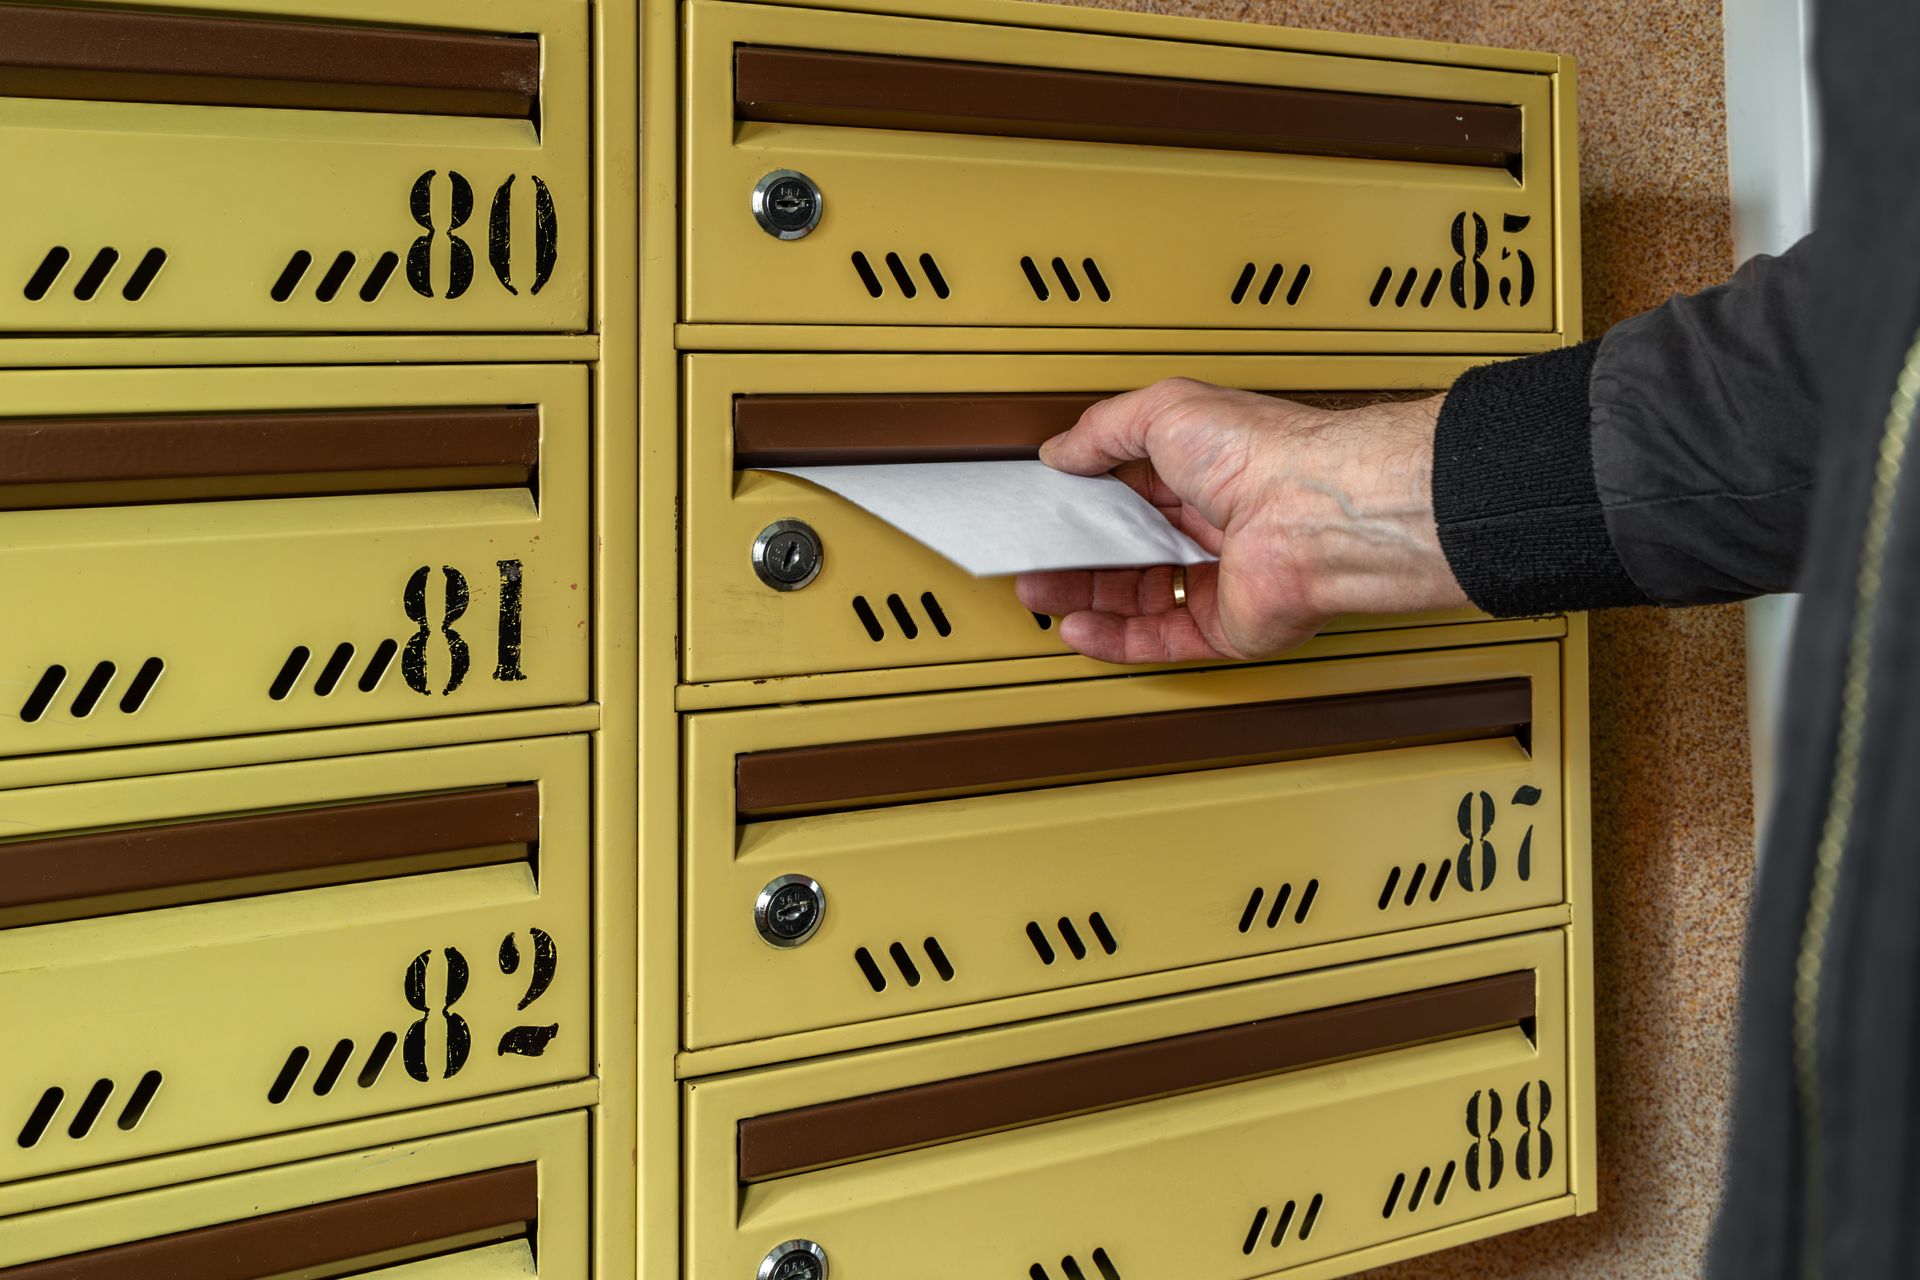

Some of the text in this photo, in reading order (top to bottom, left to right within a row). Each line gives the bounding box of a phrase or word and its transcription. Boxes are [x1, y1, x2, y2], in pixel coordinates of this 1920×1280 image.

[406, 169, 558, 299] 80
[1450, 211, 1534, 310] 85
[402, 559, 526, 695] 81
[1457, 784, 1542, 892] 87
[403, 928, 559, 1082] 82
[1465, 1080, 1553, 1191] 88
